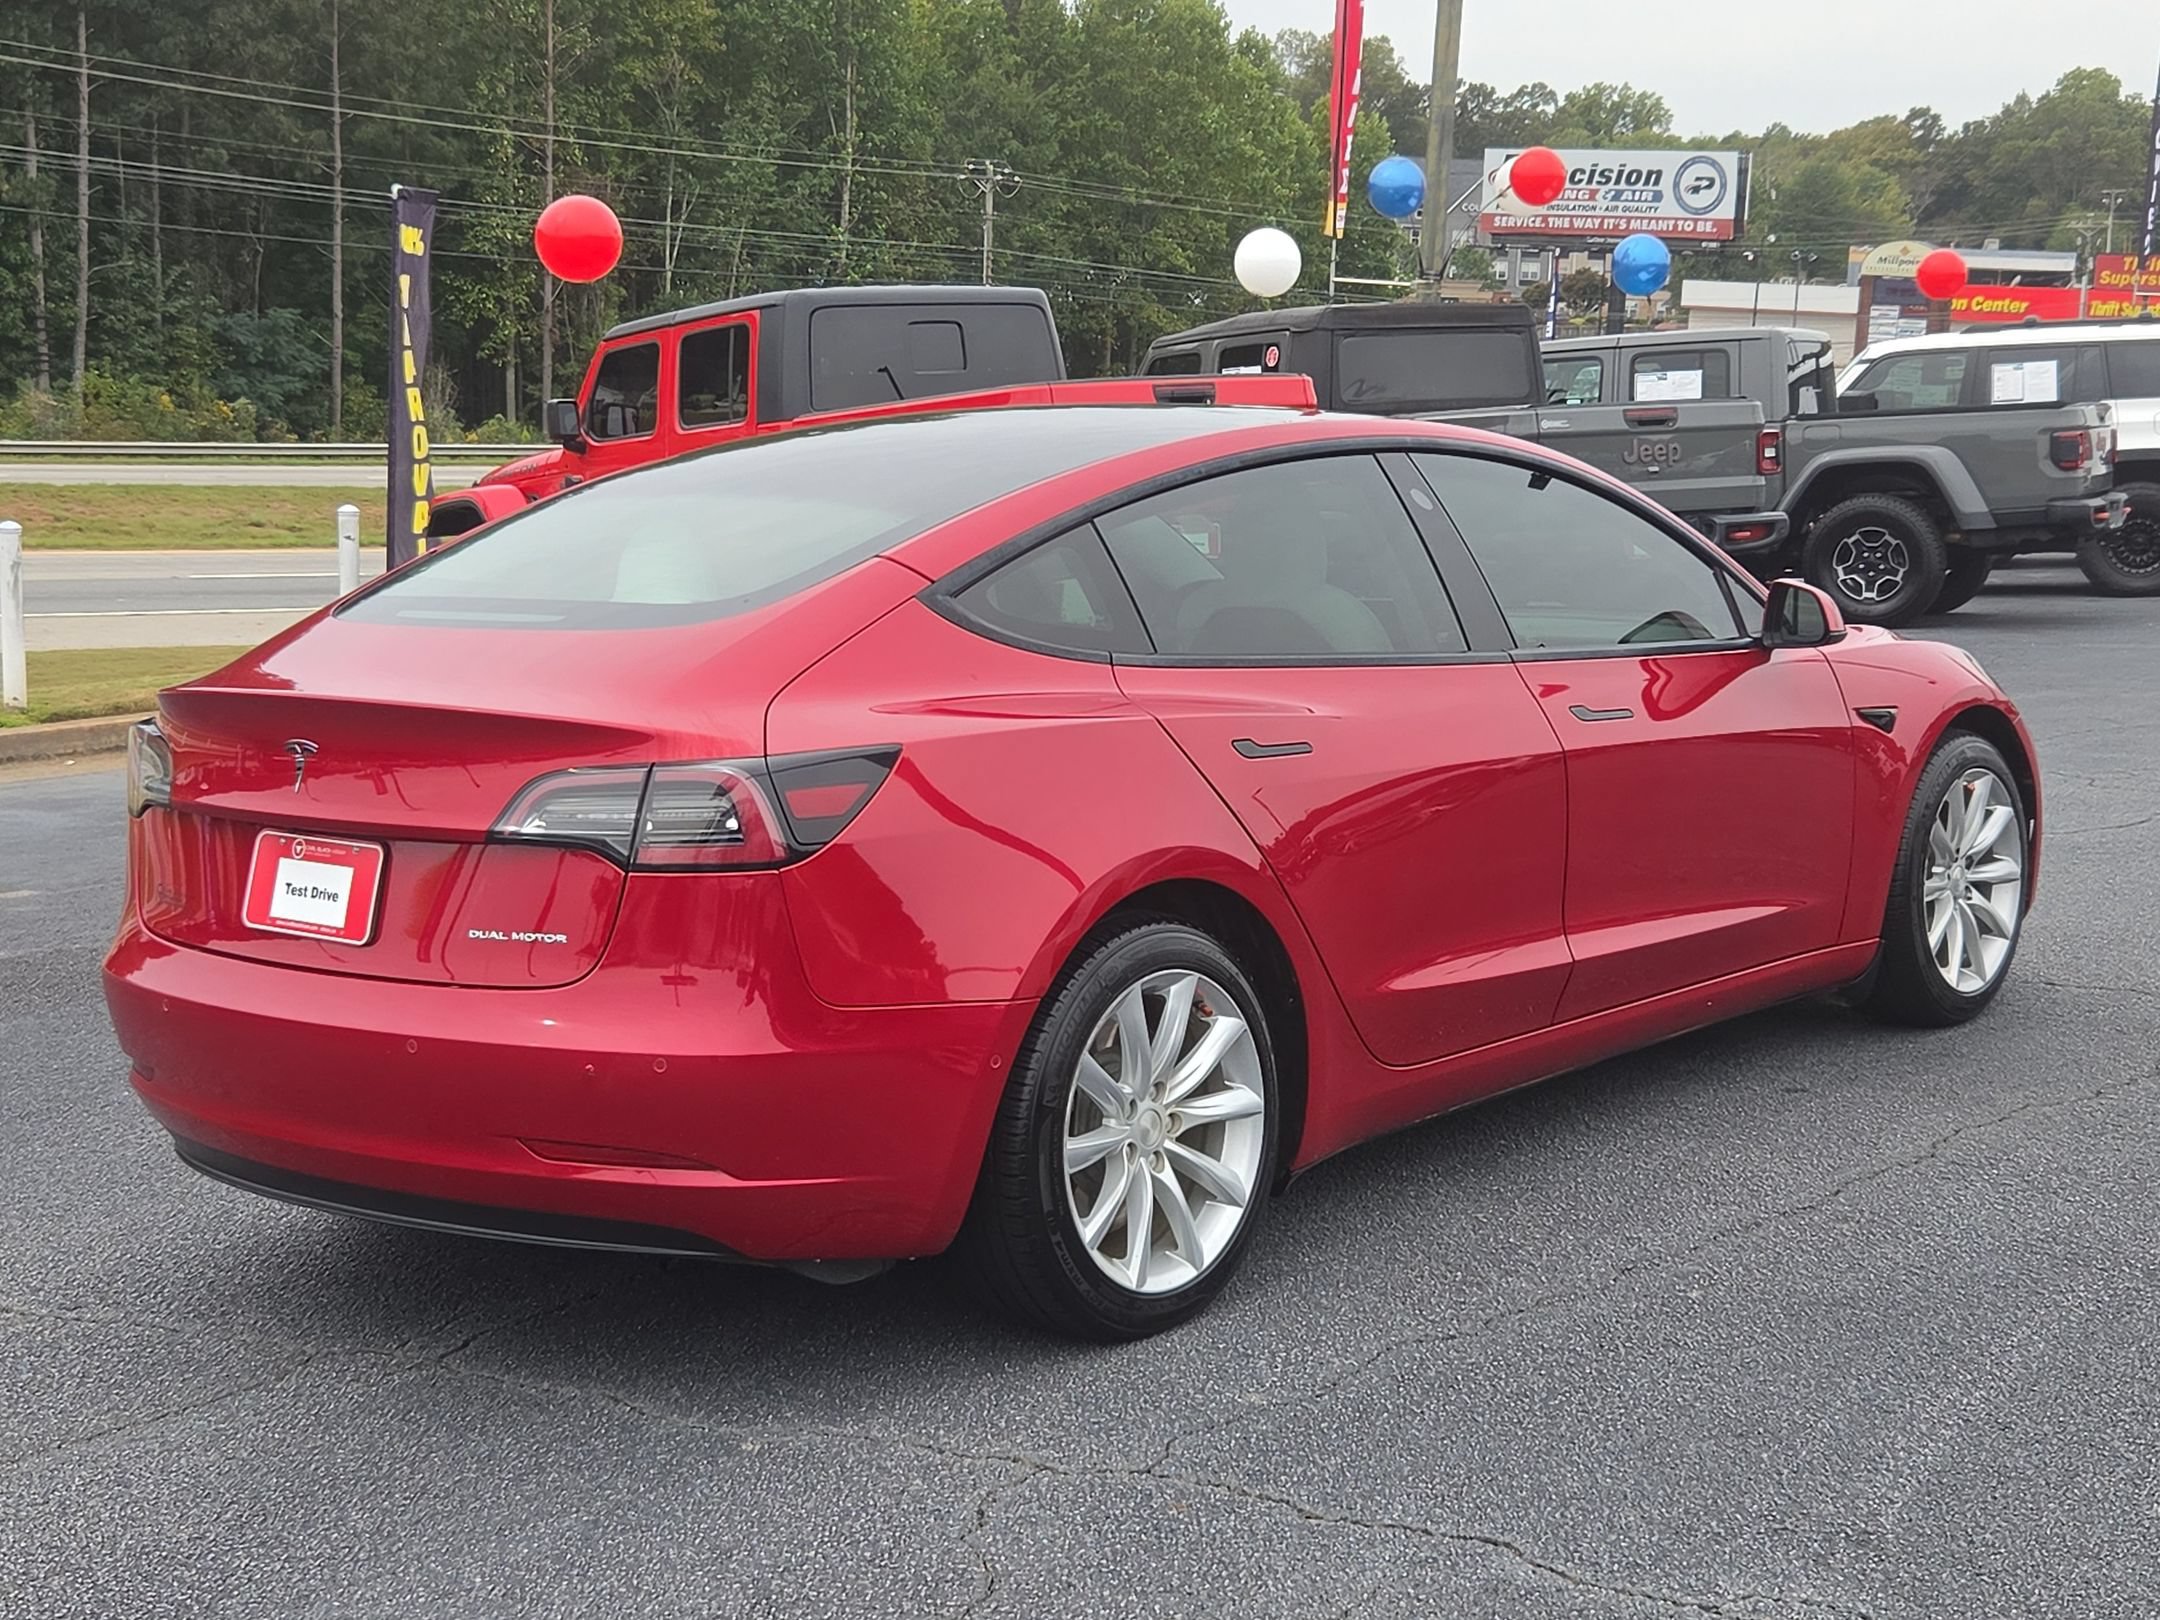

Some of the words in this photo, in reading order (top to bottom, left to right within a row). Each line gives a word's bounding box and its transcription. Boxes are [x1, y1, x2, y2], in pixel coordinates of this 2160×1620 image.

[1567, 163, 1663, 187] cision
[1620, 190, 1654, 202] AIR
[1547, 203, 1597, 213] INSULATION
[1603, 204, 1620, 213] AIR
[1621, 204, 1660, 214] QUALITY
[1492, 215, 1546, 228] SERVICE.
[1548, 217, 1571, 229] THE
[1573, 218, 1602, 230] WAY
[1603, 218, 1628, 231] IT'S
[1629, 219, 1675, 232] MEANT
[1676, 220, 1695, 232] TO
[1696, 221, 1718, 234] BE.
[1876, 255, 1920, 267] Millpoin
[1971, 296, 2029, 313] Center
[1623, 438, 1682, 467] Jeep
[285, 882, 308, 898] Test
[310, 886, 339, 902] Drive
[468, 929, 509, 941] DUAL
[511, 931, 568, 944] MOTOR
